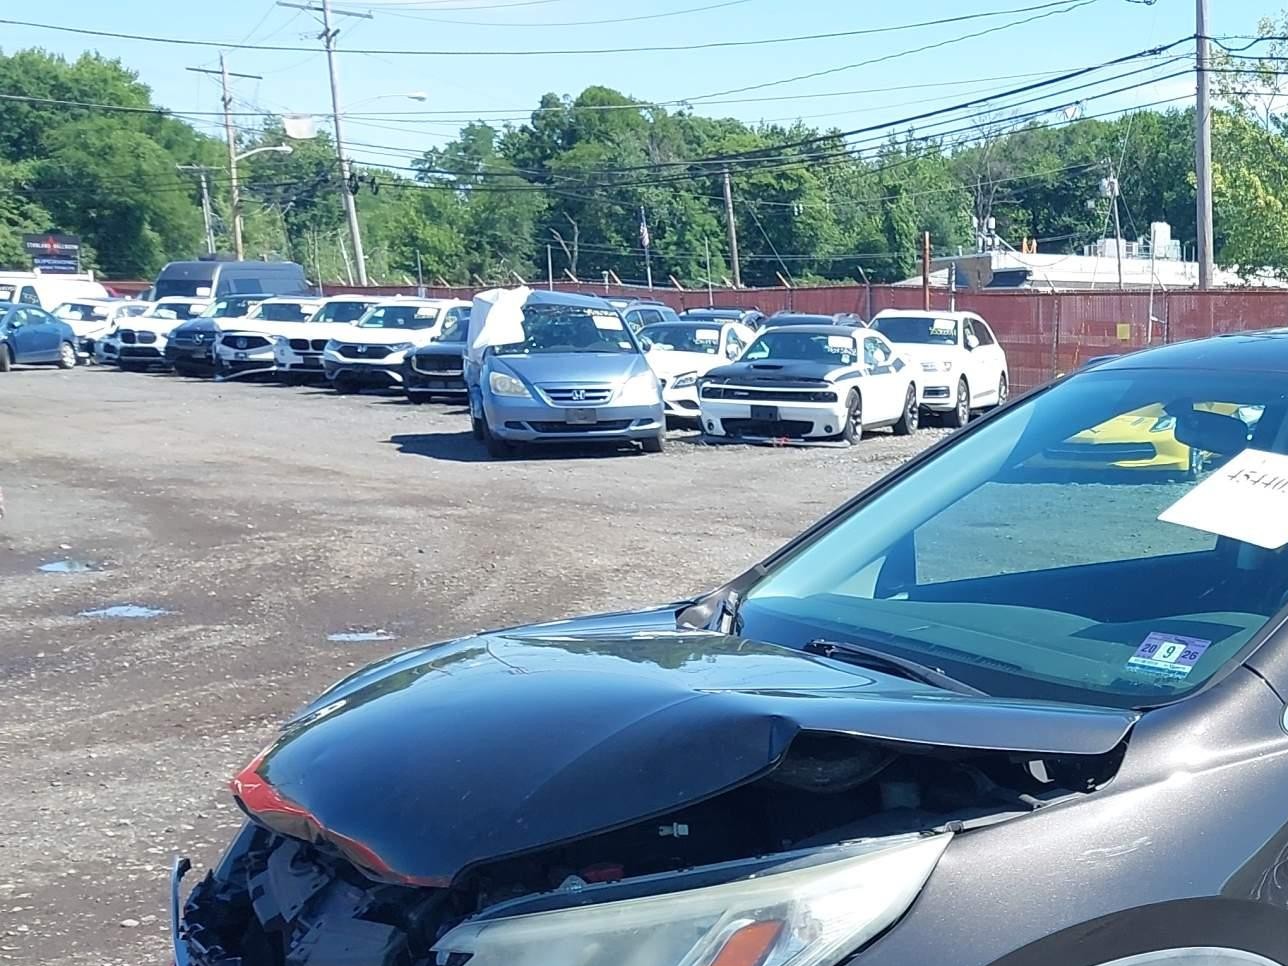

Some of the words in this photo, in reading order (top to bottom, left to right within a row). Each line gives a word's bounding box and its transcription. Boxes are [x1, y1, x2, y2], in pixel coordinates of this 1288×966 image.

[1141, 643, 1158, 654] 20
[1162, 645, 1177, 659] 9
[1180, 650, 1199, 660] 26
